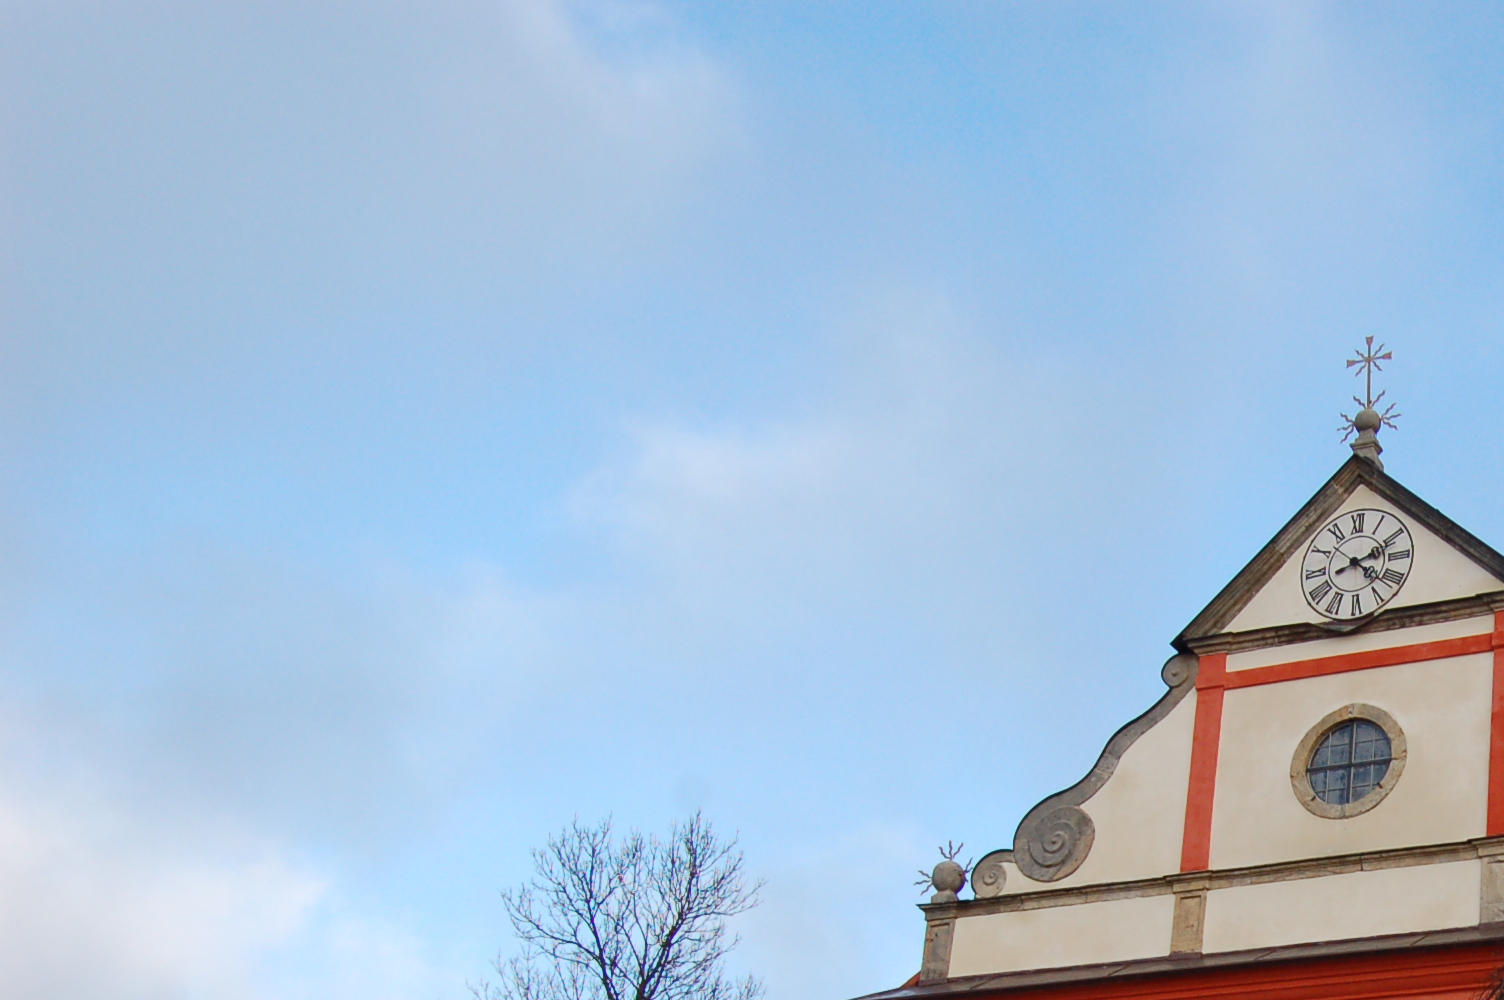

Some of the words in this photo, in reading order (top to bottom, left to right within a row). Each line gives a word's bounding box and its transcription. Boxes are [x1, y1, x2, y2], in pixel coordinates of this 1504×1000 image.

[1327, 523, 1345, 544] XI
[1351, 513, 1365, 535] XII
[1311, 545, 1331, 559] X
[1388, 549, 1410, 562] III
[1351, 593, 1363, 616] VI
